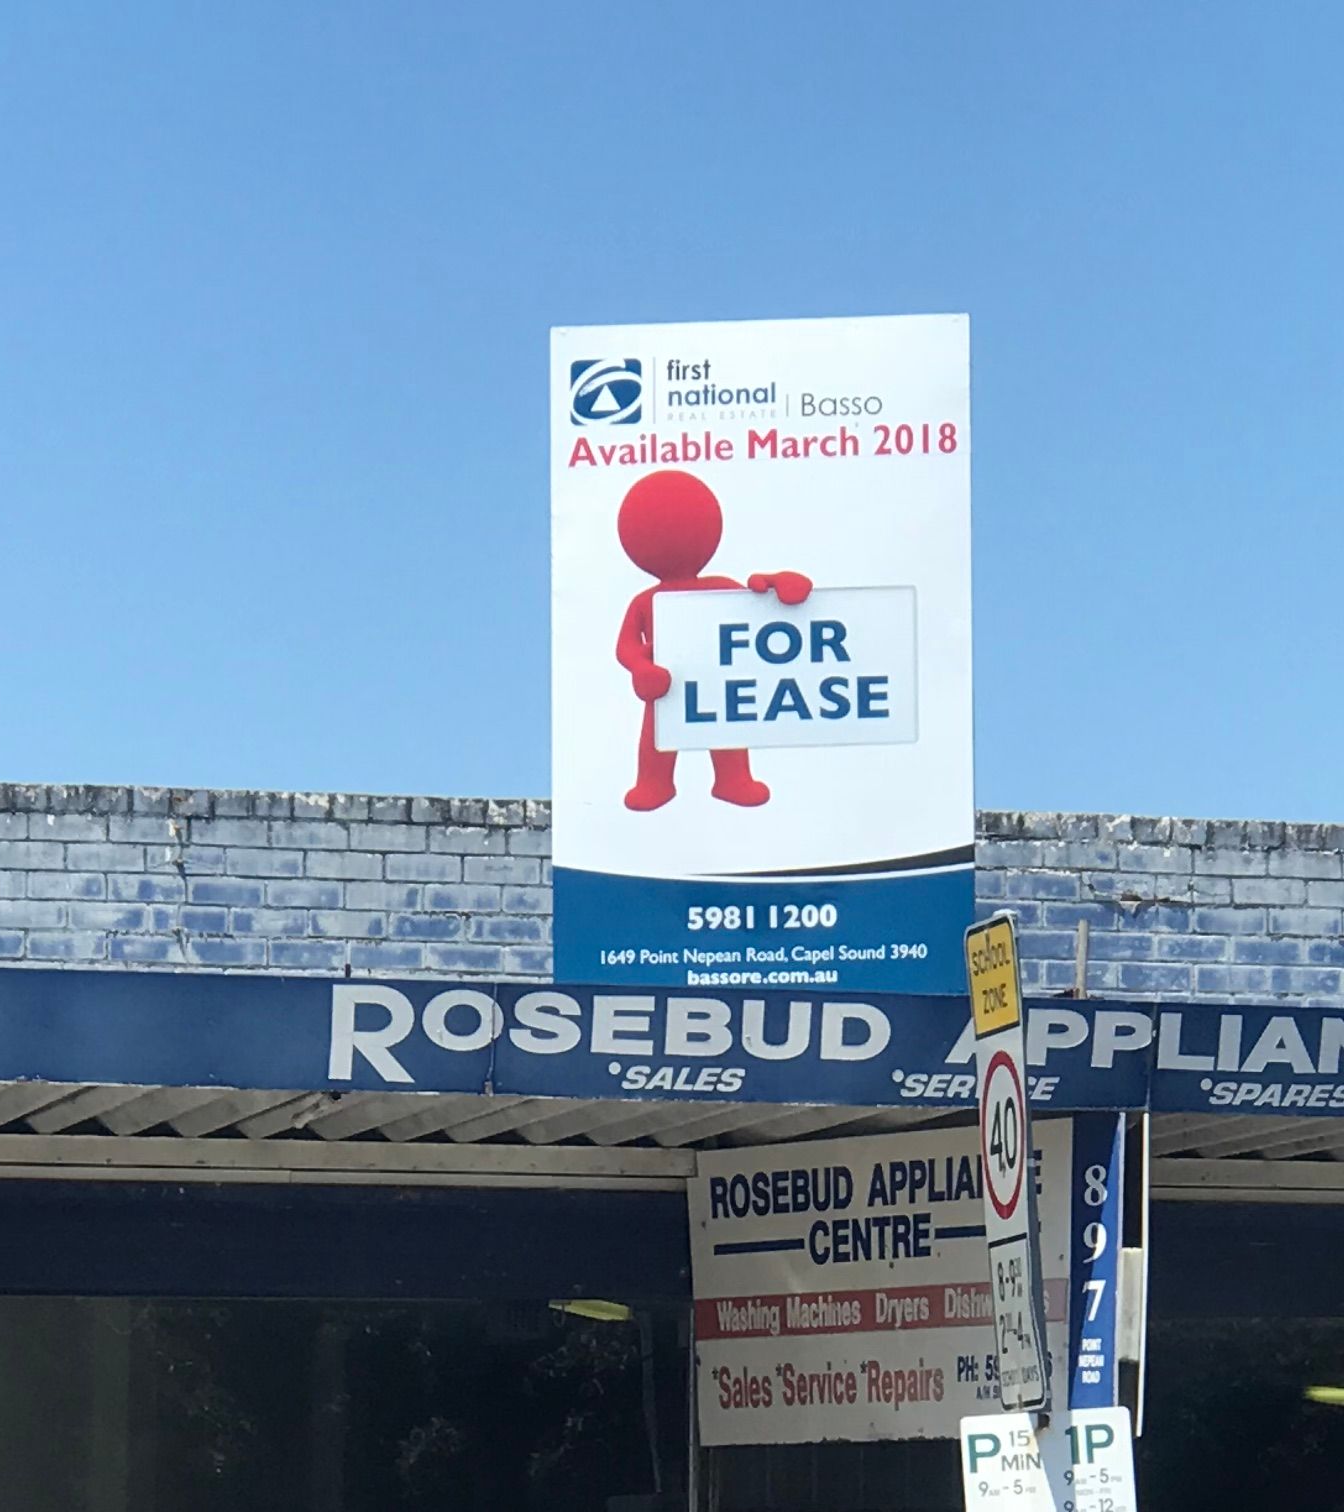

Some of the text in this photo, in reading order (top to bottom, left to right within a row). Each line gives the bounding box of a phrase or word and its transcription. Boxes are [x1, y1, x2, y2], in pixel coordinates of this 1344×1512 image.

[666, 359, 711, 381] first
[668, 382, 776, 407] national
[801, 393, 883, 417] Basso
[568, 422, 957, 468] Available March 2018
[719, 619, 851, 666] FOR
[684, 676, 890, 723] LEASE
[687, 904, 837, 930] 5981 1200
[600, 943, 928, 967] 1649 Point Nepean Road, Capel Sound 3940
[687, 969, 838, 985] bassore.com.au
[982, 983, 1008, 1015] ZONE
[328, 984, 891, 1083] ROSEBUD
[900, 1074, 1060, 1100] SERE
[991, 1096, 1017, 1171] 40
[710, 1150, 1043, 1219] ROSEBUD APPLIAE
[809, 1213, 932, 1264] CENTRE
[717, 1299, 780, 1335] Washing
[786, 1296, 862, 1329] Machines
[876, 1293, 929, 1329] Dryers
[967, 1430, 1031, 1473] P 15
[1065, 1424, 1114, 1465] 1P
